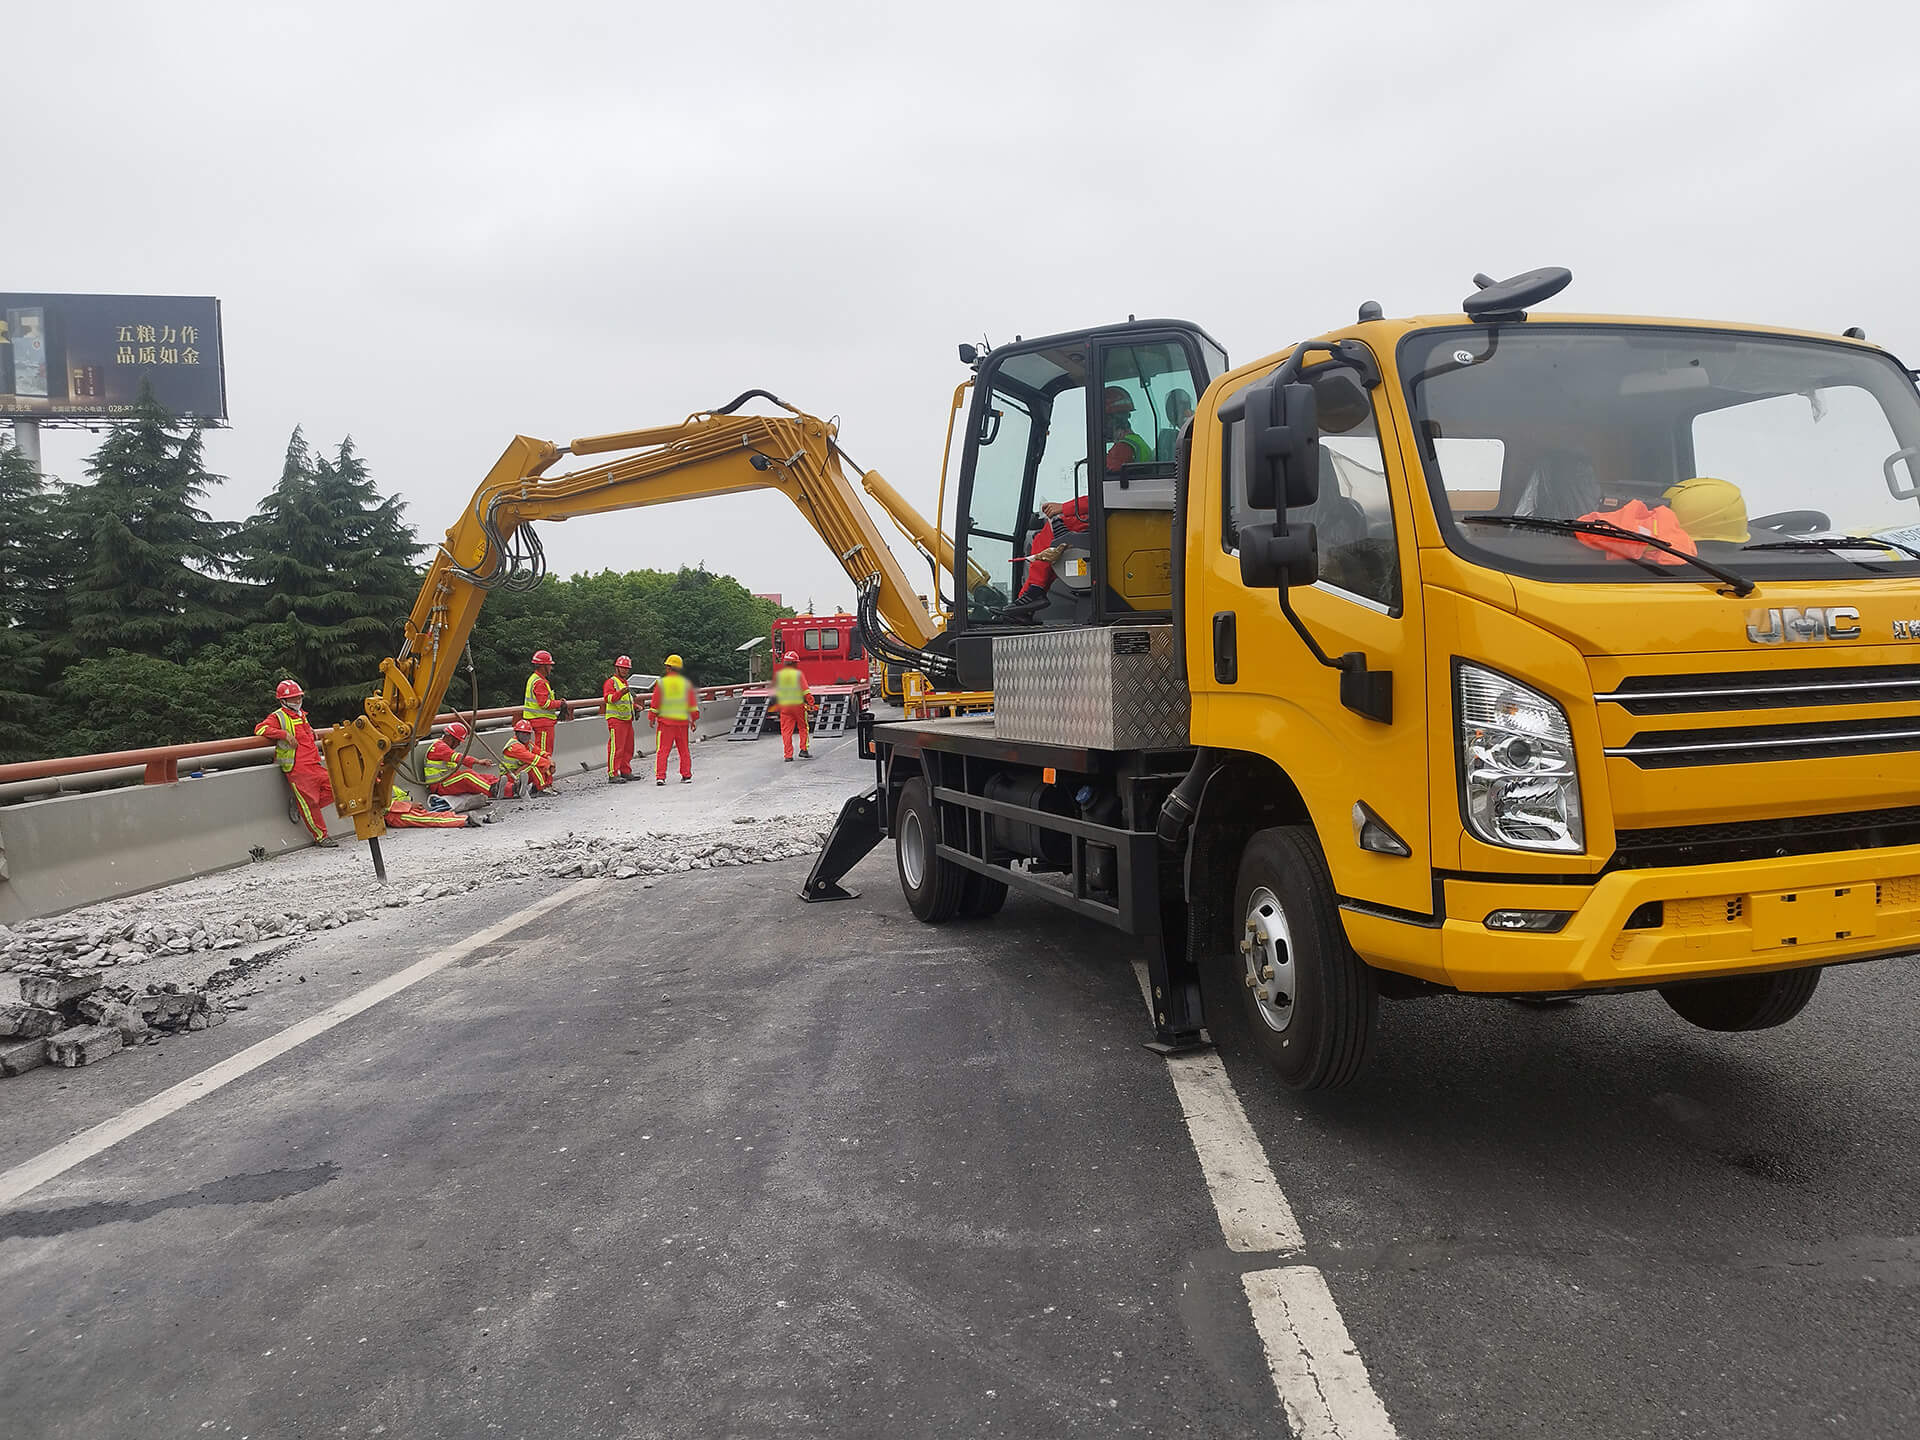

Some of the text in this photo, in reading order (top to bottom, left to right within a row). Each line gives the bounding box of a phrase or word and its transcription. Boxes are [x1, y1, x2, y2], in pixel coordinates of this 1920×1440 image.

[116, 325, 199, 344] 五粮力作
[117, 347, 200, 364] 品质如金
[1747, 606, 1861, 644] JMC
